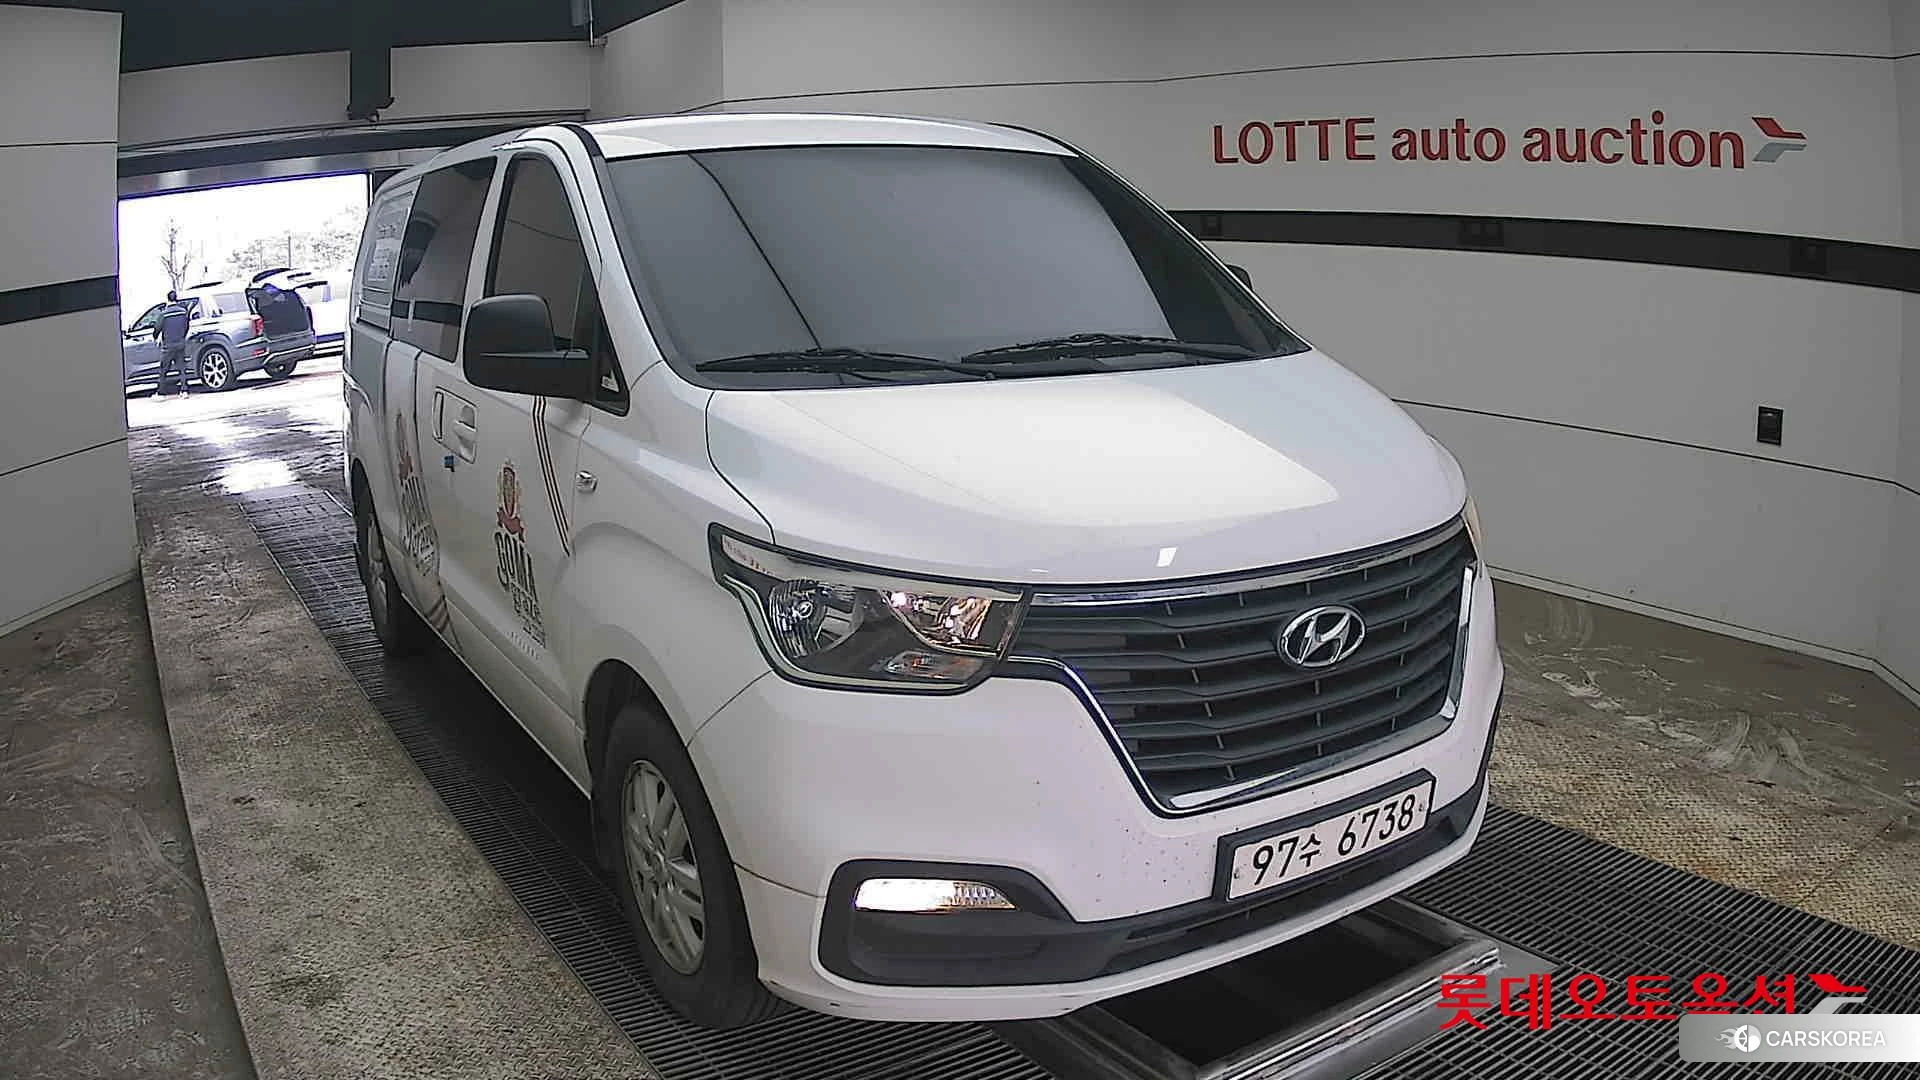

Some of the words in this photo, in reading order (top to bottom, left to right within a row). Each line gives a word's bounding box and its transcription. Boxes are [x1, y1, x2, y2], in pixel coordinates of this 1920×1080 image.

[1212, 117, 1376, 165] LOTTE
[1391, 117, 1507, 163] auto
[1521, 110, 1746, 169] auction
[1252, 833, 1321, 886] 97수
[1337, 793, 1417, 857] 6738
